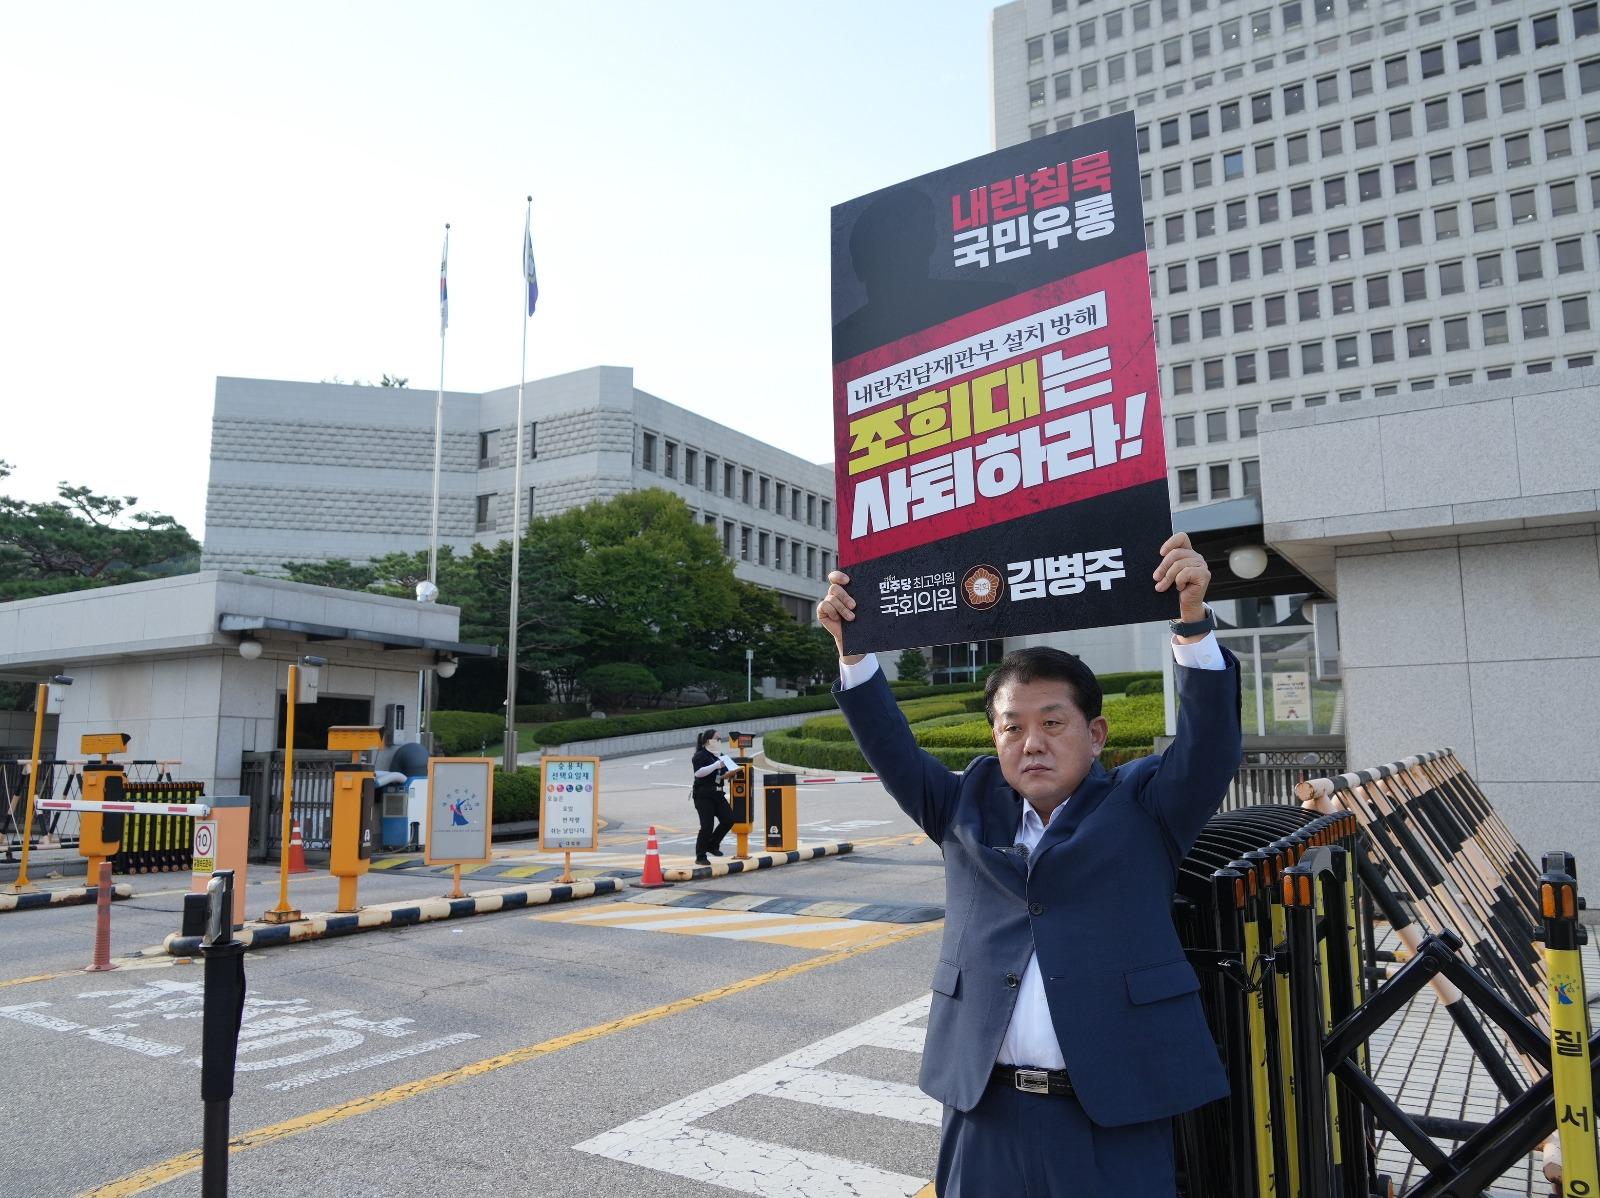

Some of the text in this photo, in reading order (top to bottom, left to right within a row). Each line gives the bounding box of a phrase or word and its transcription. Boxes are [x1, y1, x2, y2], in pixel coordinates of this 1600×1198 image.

[952, 150, 1112, 231] 내란침묵
[953, 192, 1115, 268] 국민우롱
[854, 304, 1097, 404] 내란전담재판부 설치 방해
[848, 345, 1112, 476] 조희대는
[850, 392, 1147, 540] 사퇴하라!
[879, 571, 956, 594] 민주당 최고위원
[879, 587, 958, 617] 국회의원
[1006, 547, 1126, 602] 김병주
[552, 772, 589, 780] 선택요일제
[198, 833, 208, 847] 10
